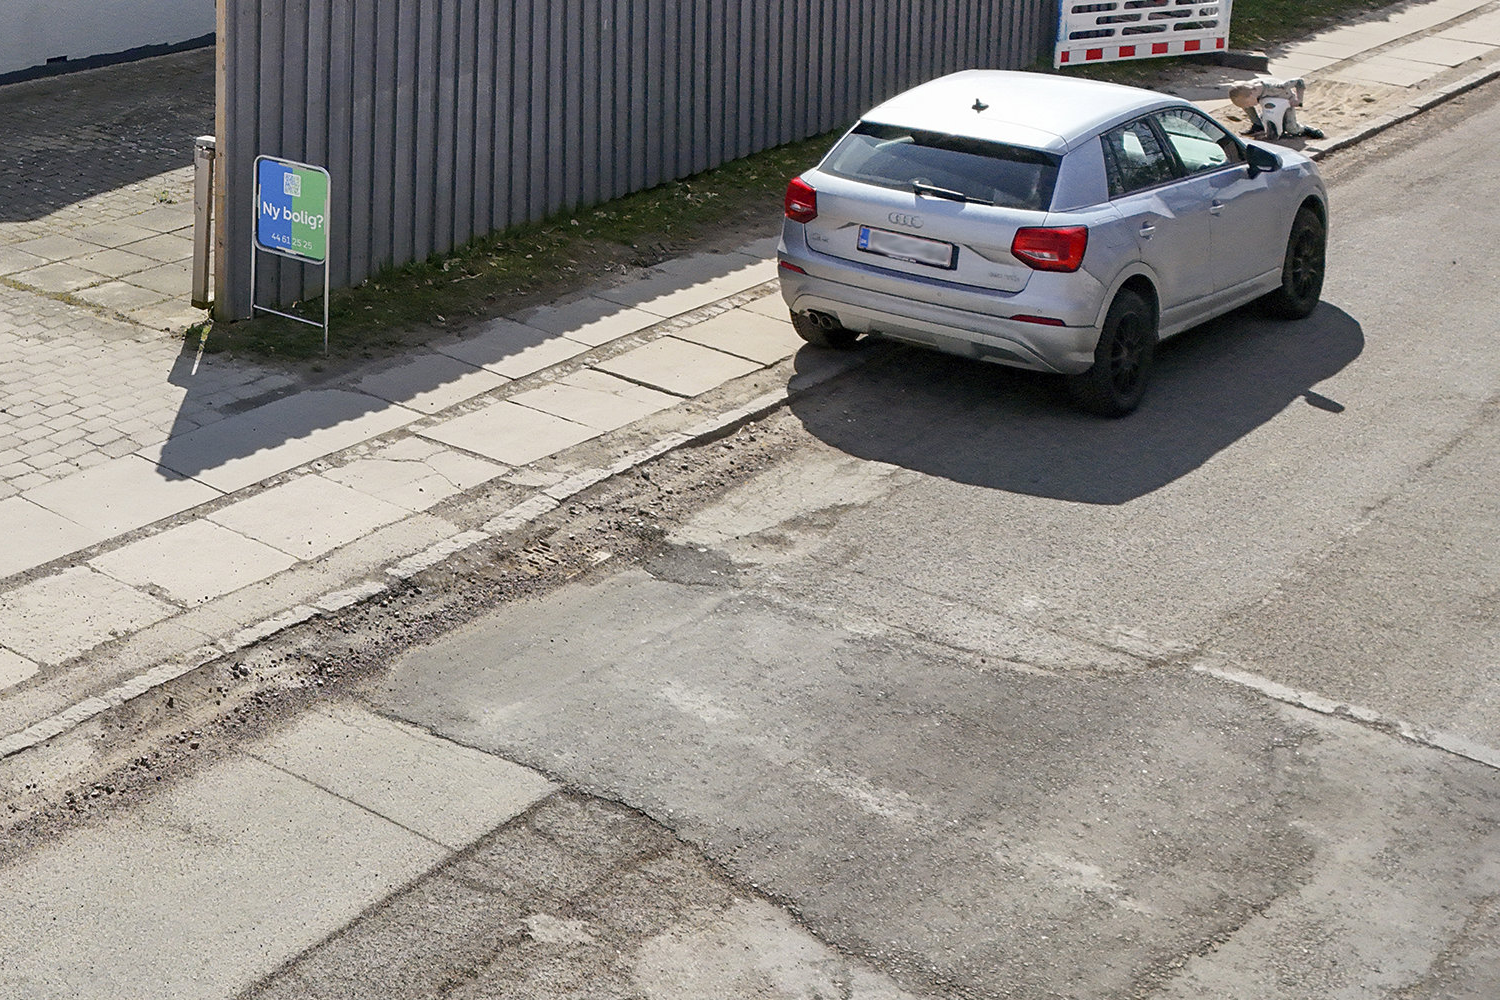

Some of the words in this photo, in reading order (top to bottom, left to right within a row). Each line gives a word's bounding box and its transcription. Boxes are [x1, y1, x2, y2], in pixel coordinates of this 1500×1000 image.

[262, 201, 280, 220] Ny
[283, 206, 324, 229] bolig?
[271, 232, 281, 242] 44
[281, 235, 291, 244] 61
[292, 237, 302, 247] 25
[303, 240, 313, 250] 25
